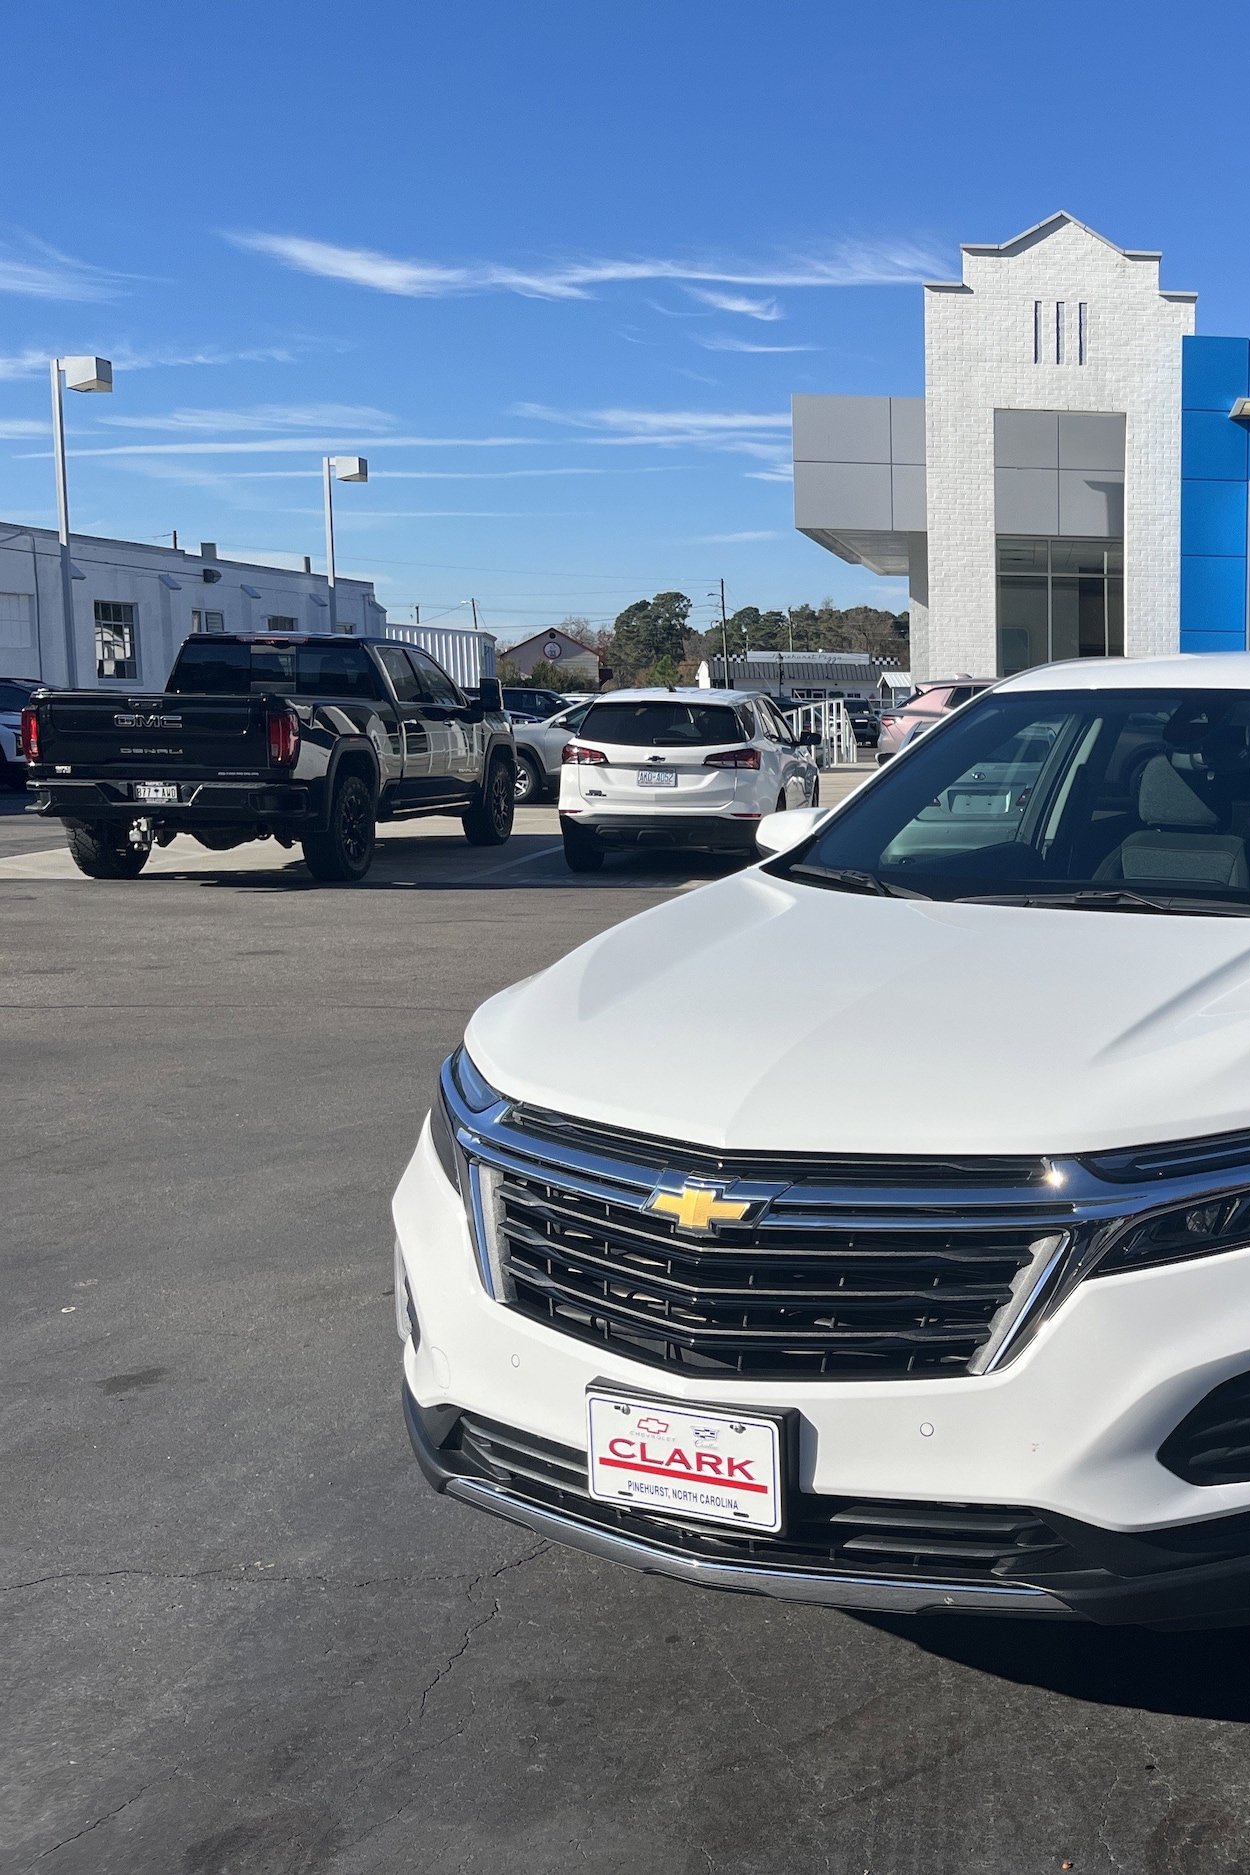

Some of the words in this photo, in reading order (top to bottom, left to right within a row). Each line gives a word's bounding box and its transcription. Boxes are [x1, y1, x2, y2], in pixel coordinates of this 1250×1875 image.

[114, 714, 183, 728] GMC
[629, 1430, 676, 1442] CHEVROLET
[608, 1438, 755, 1481] CLARK
[627, 1480, 671, 1499] PINEHURST,
[672, 1489, 698, 1503] NORTH
[699, 1493, 739, 1510] CAROLINA
